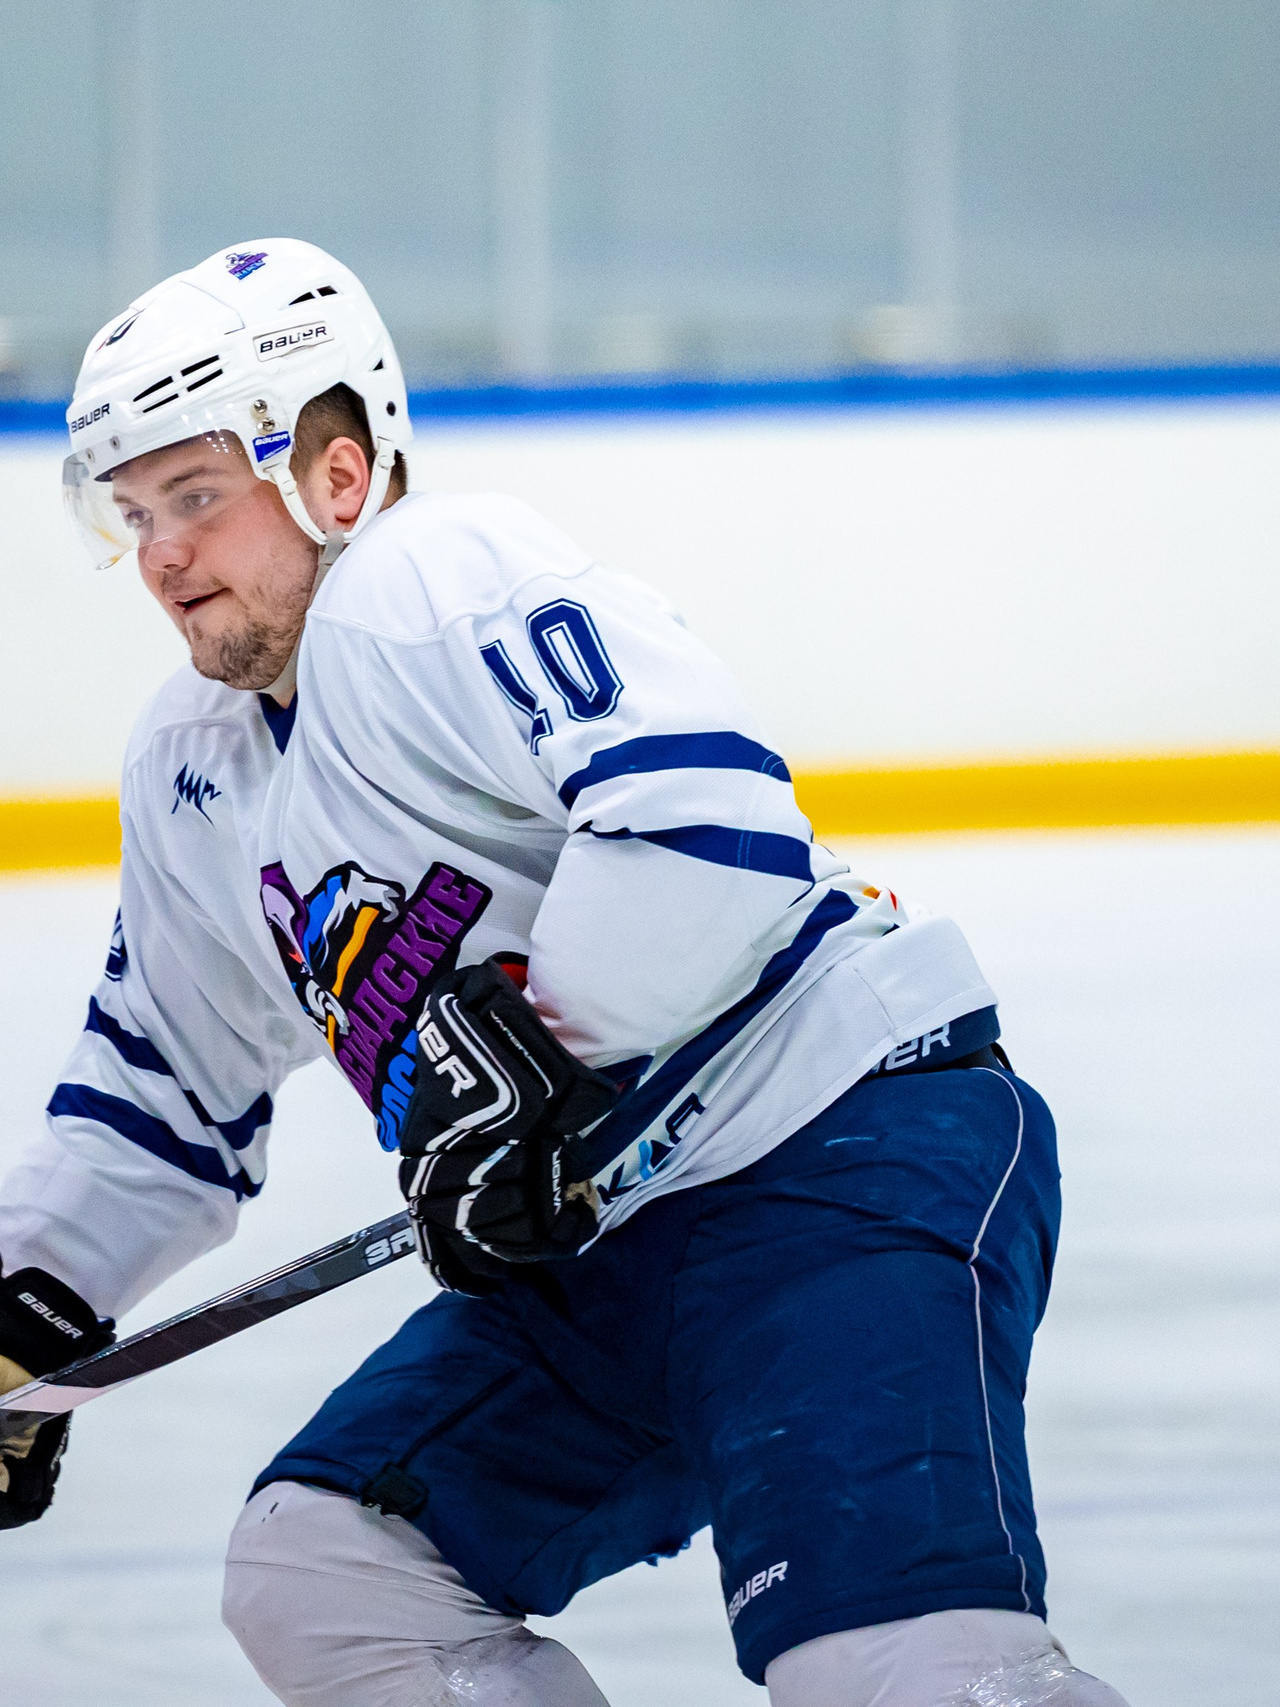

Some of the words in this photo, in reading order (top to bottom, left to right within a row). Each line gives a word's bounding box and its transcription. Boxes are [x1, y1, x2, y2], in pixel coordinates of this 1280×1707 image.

[259, 325, 328, 355] BAUER
[70, 402, 111, 434] BAUER
[478, 598, 625, 756] 10
[18, 1291, 84, 1340] BAUER
